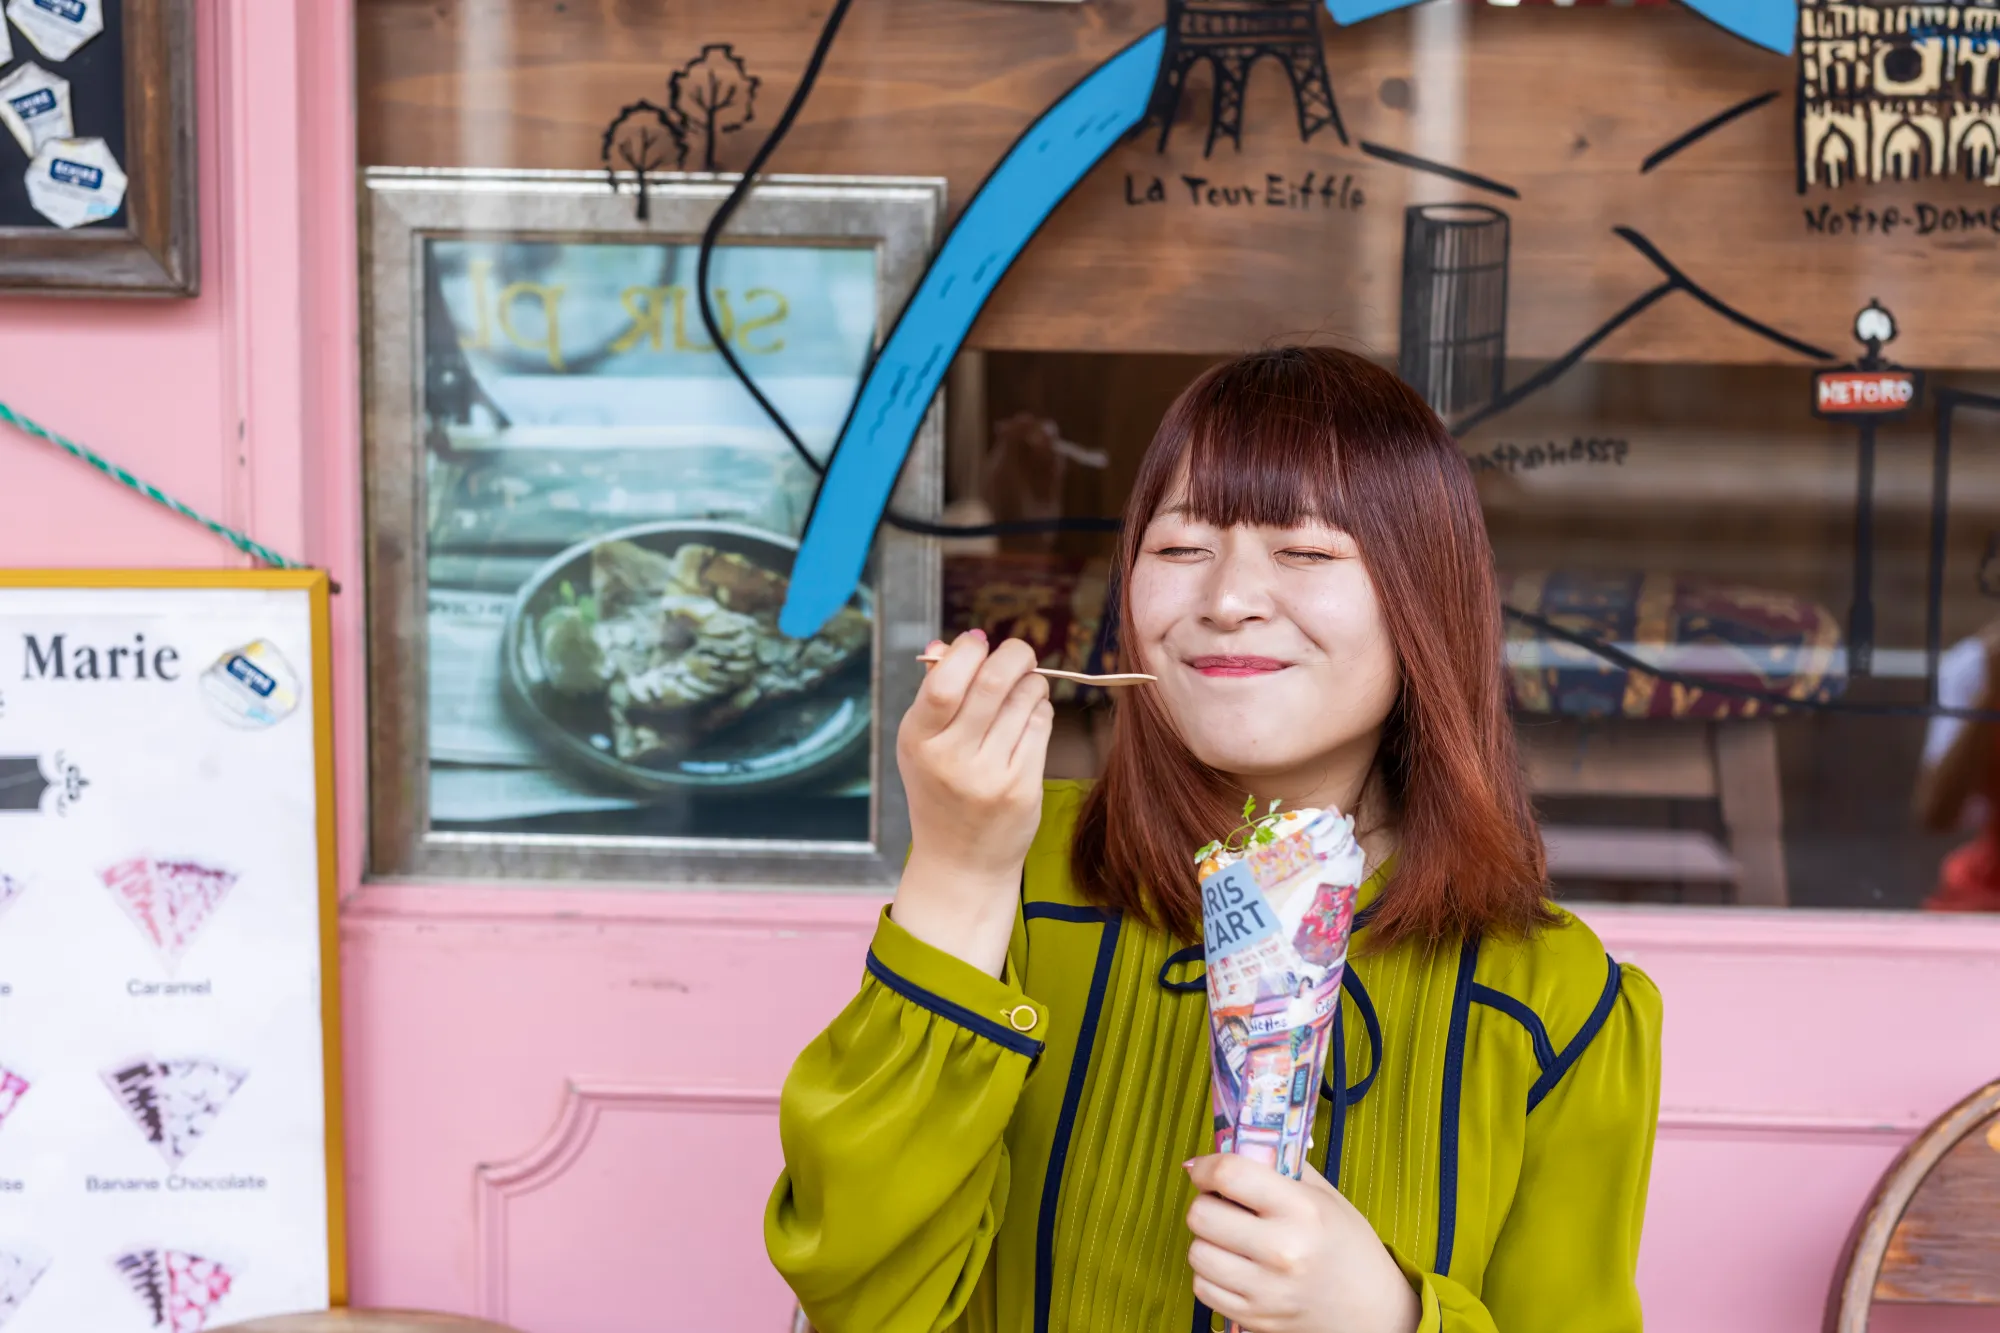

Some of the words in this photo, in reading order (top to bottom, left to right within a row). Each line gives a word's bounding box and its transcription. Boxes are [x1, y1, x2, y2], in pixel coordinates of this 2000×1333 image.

[1124, 172, 1166, 206] La
[22, 632, 180, 682] Marie
[126, 978, 212, 996] Caramel
[86, 1175, 160, 1191] Banane
